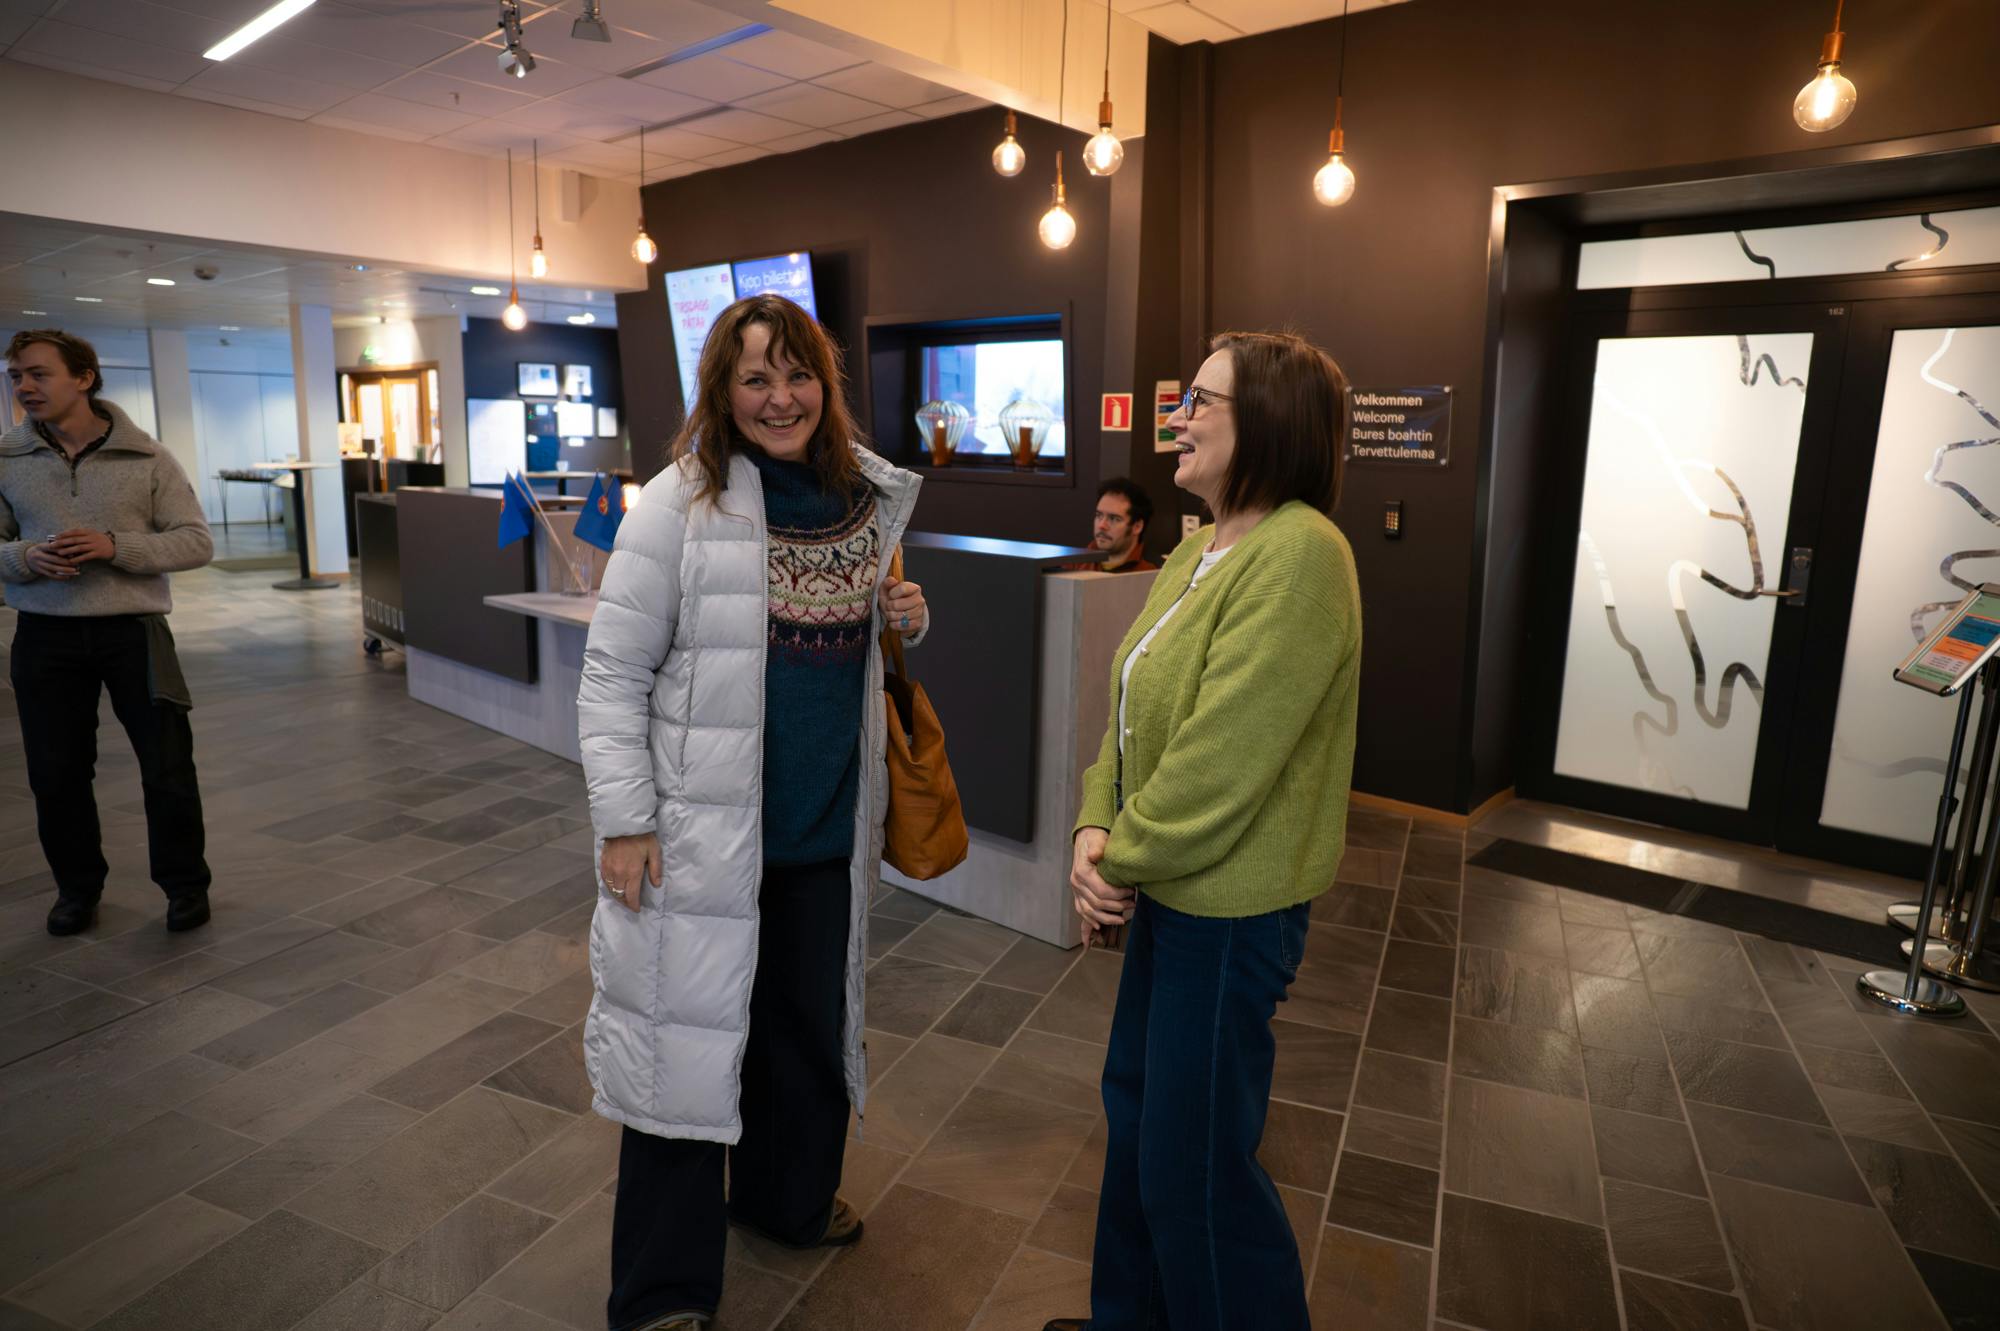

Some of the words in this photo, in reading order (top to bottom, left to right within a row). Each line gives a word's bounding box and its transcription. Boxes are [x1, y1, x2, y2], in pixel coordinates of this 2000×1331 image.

[1354, 393, 1422, 406] Velkommen
[1353, 411, 1405, 423] Welcome
[1352, 427, 1385, 440] Bures
[1388, 428, 1433, 441] boahtin
[1352, 444, 1435, 459] Tervettulemaa
